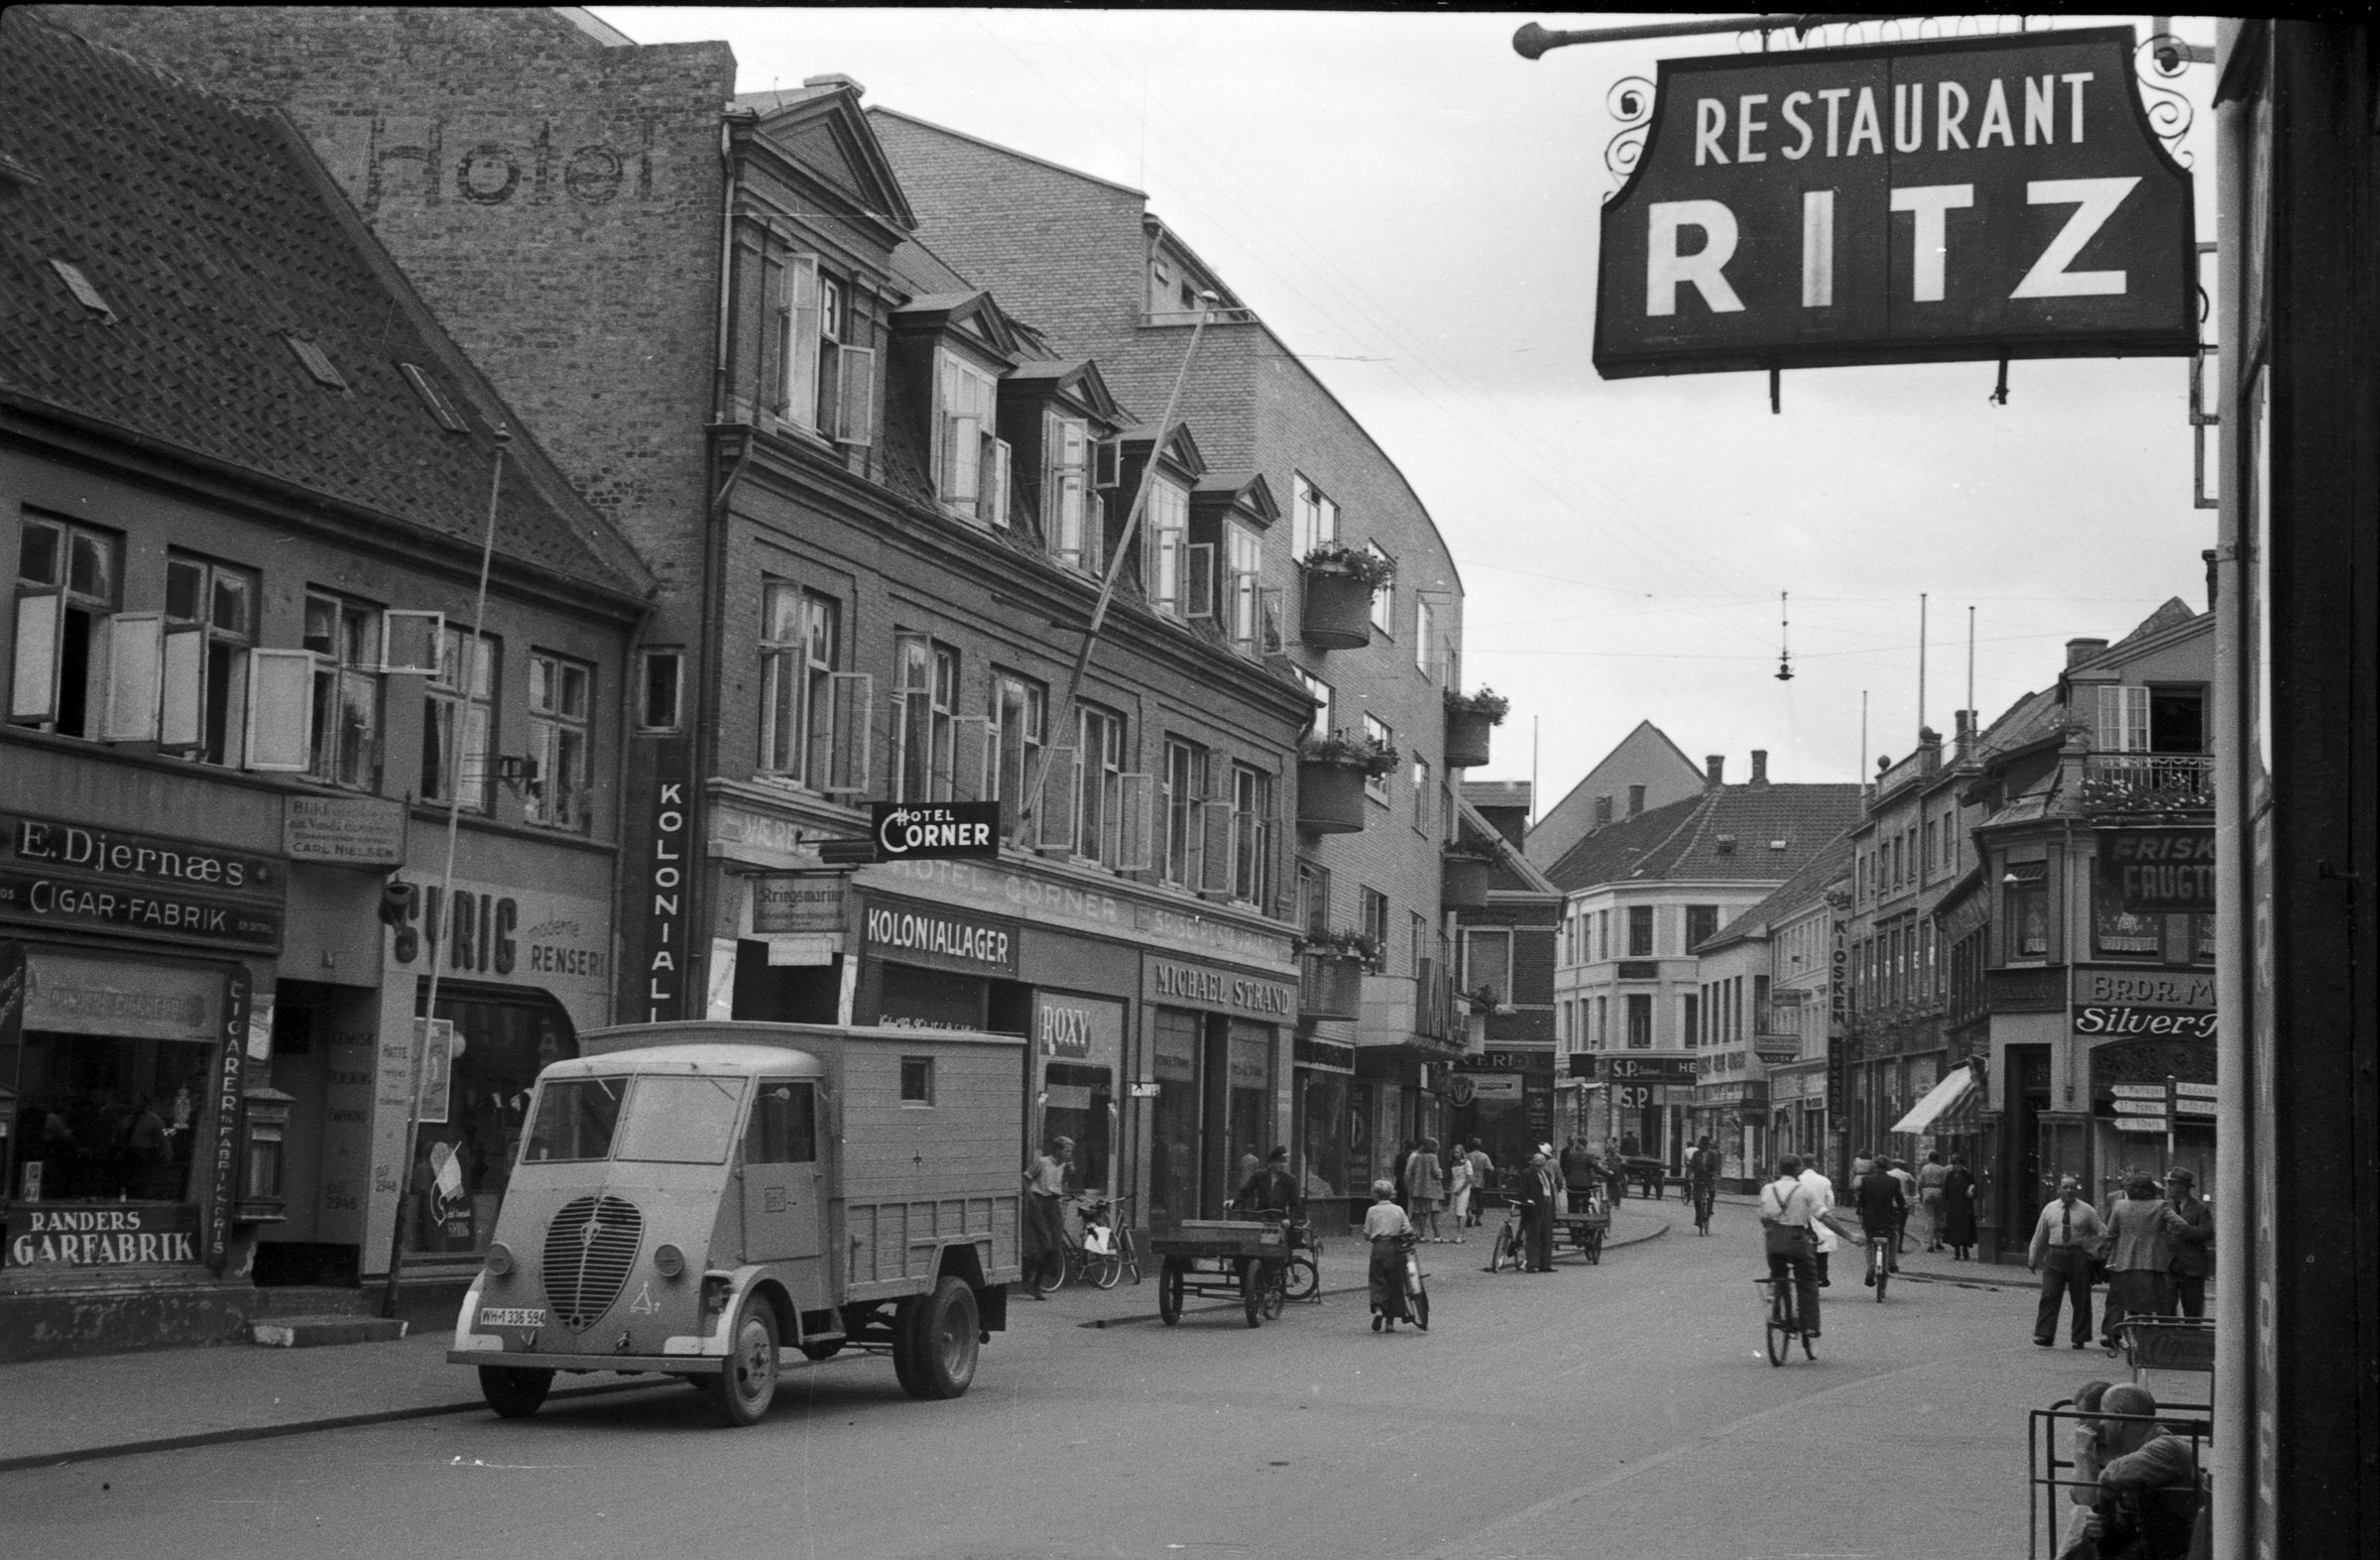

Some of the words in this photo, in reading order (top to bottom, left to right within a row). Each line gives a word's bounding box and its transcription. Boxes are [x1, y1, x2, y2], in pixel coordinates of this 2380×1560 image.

[1694, 71, 2094, 168] RESTAURANT
[1646, 176, 2143, 316] RITZ
[880, 812, 991, 853] CORNER
[897, 807, 955, 826] HOTEL
[19, 820, 58, 860] E.
[62, 827, 245, 886] Djernæs
[30, 880, 227, 932] CIGAR-FABRIK
[1004, 875, 1118, 922] CORNER
[531, 943, 606, 977] RENSERI
[868, 907, 1009, 964] KOLONIALLAGER
[1155, 964, 1227, 1004] MICHAEL
[1233, 978, 1289, 1015] STRAND
[1833, 919, 1847, 1023] KIOSKEN
[2093, 976, 2181, 1002] BRDR.
[220, 978, 247, 1112] CIGARER
[1041, 1005, 1091, 1055] ROXY
[2076, 1007, 2196, 1034] Silver
[30, 1210, 142, 1232] RANDERS
[5, 1231, 194, 1266] GARFABRIK
